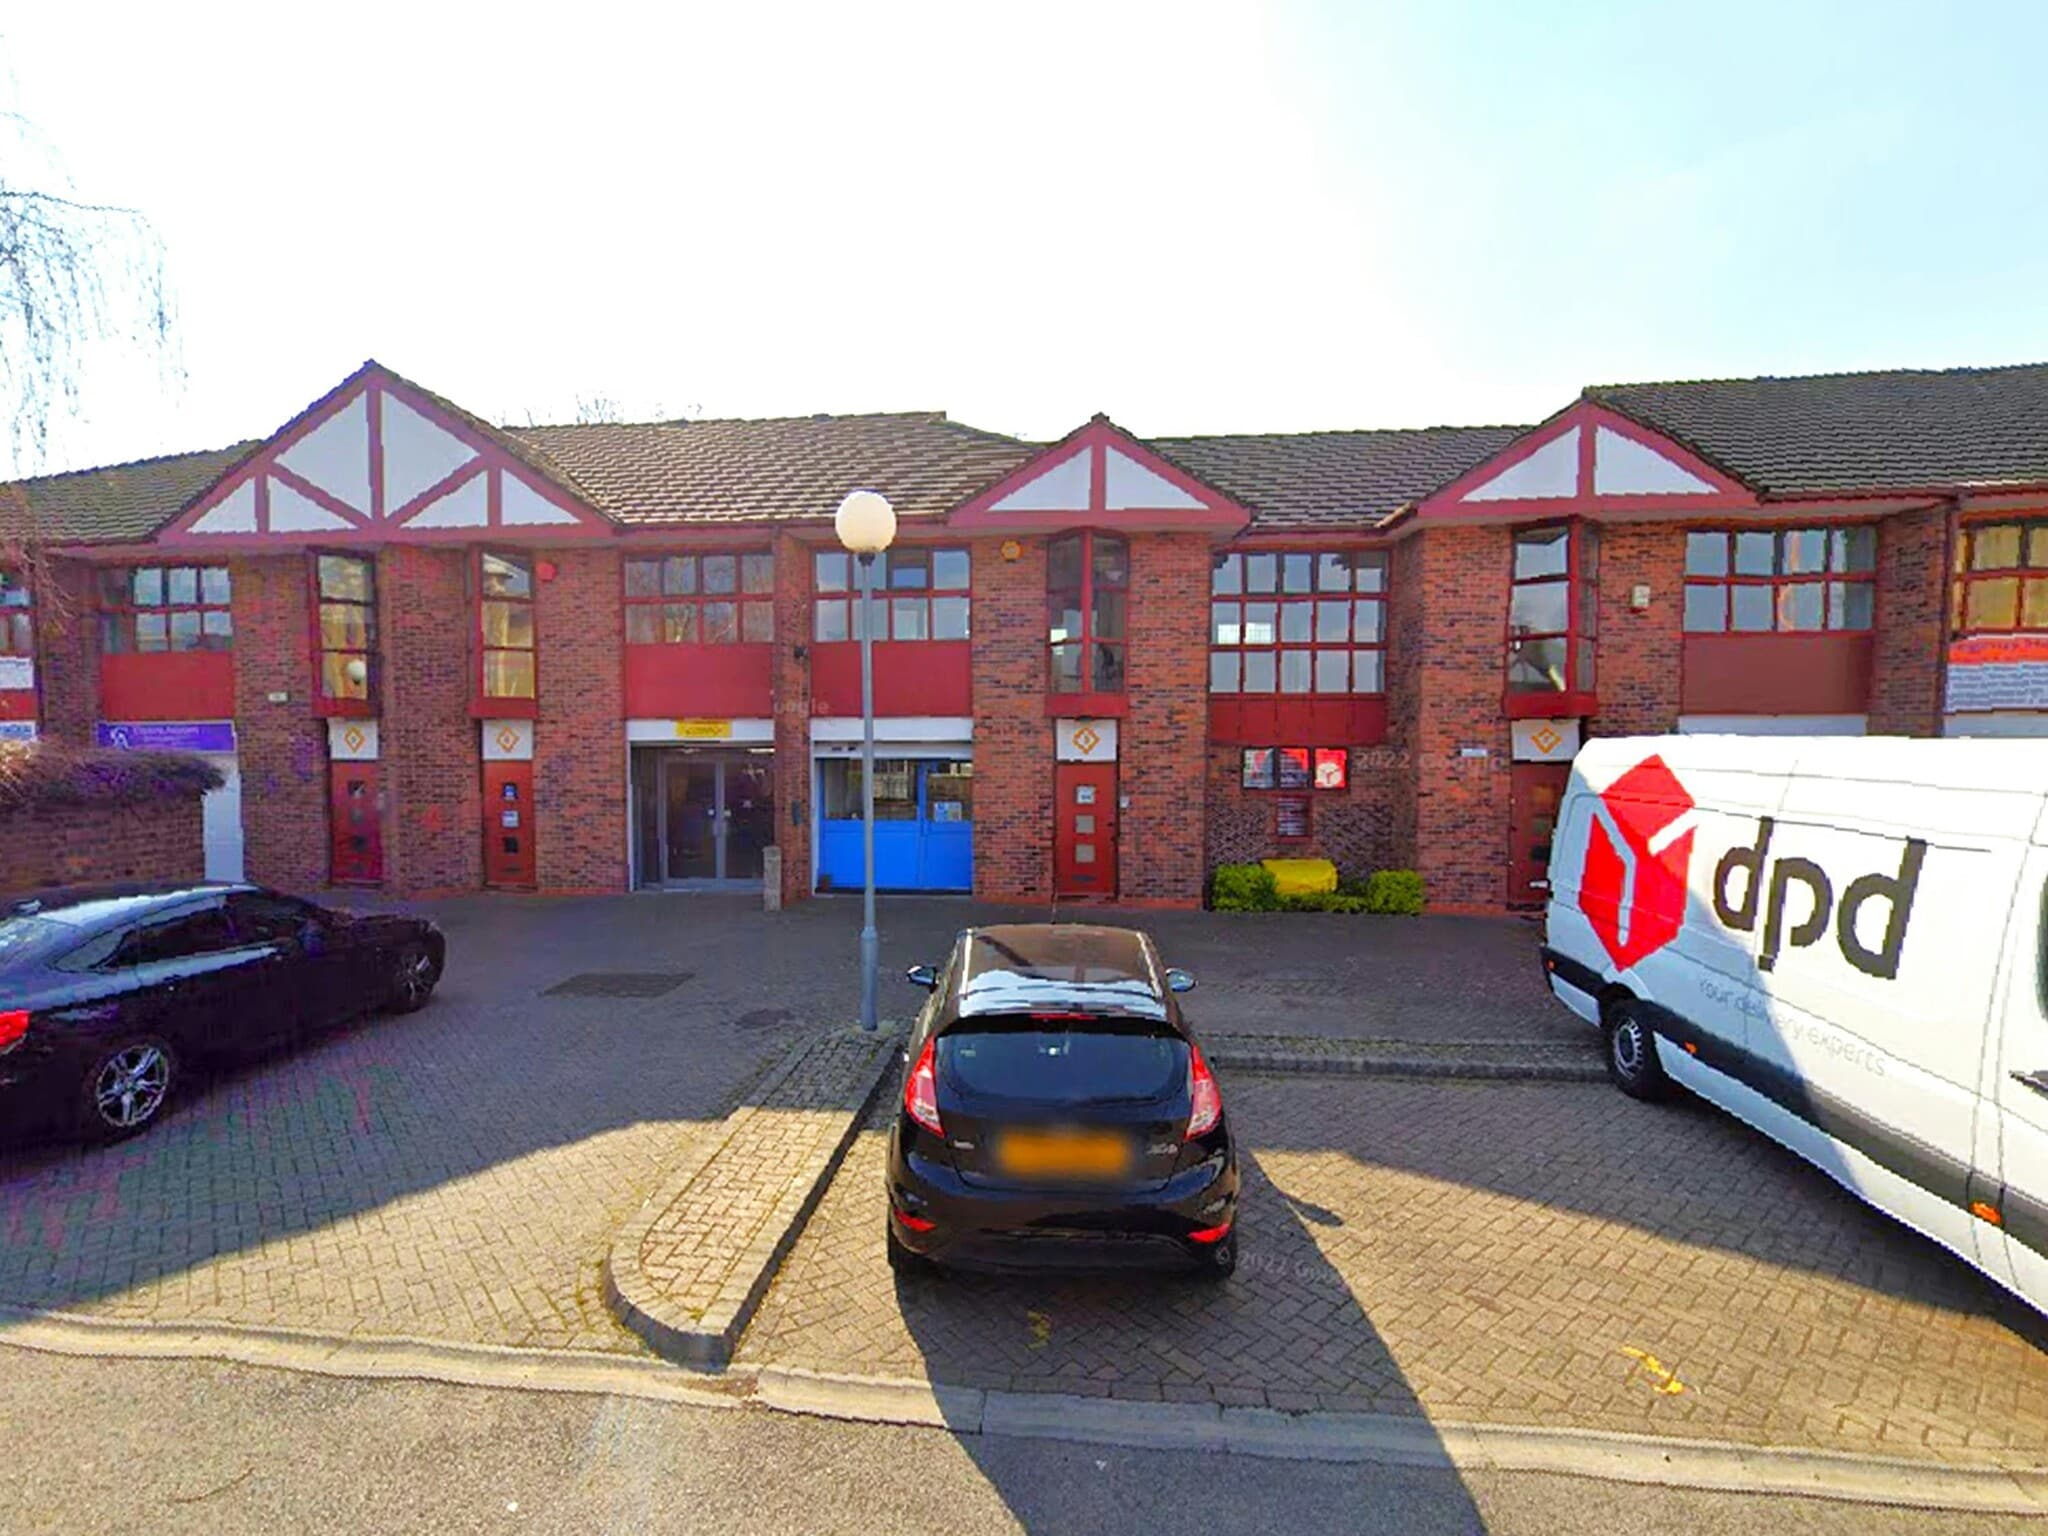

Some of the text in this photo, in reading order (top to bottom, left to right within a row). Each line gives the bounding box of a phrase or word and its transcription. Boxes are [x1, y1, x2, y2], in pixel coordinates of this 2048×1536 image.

[1713, 815, 1927, 980] dpd
[1735, 993, 1804, 1041] deliery
[1807, 1026, 1888, 1077] experts
